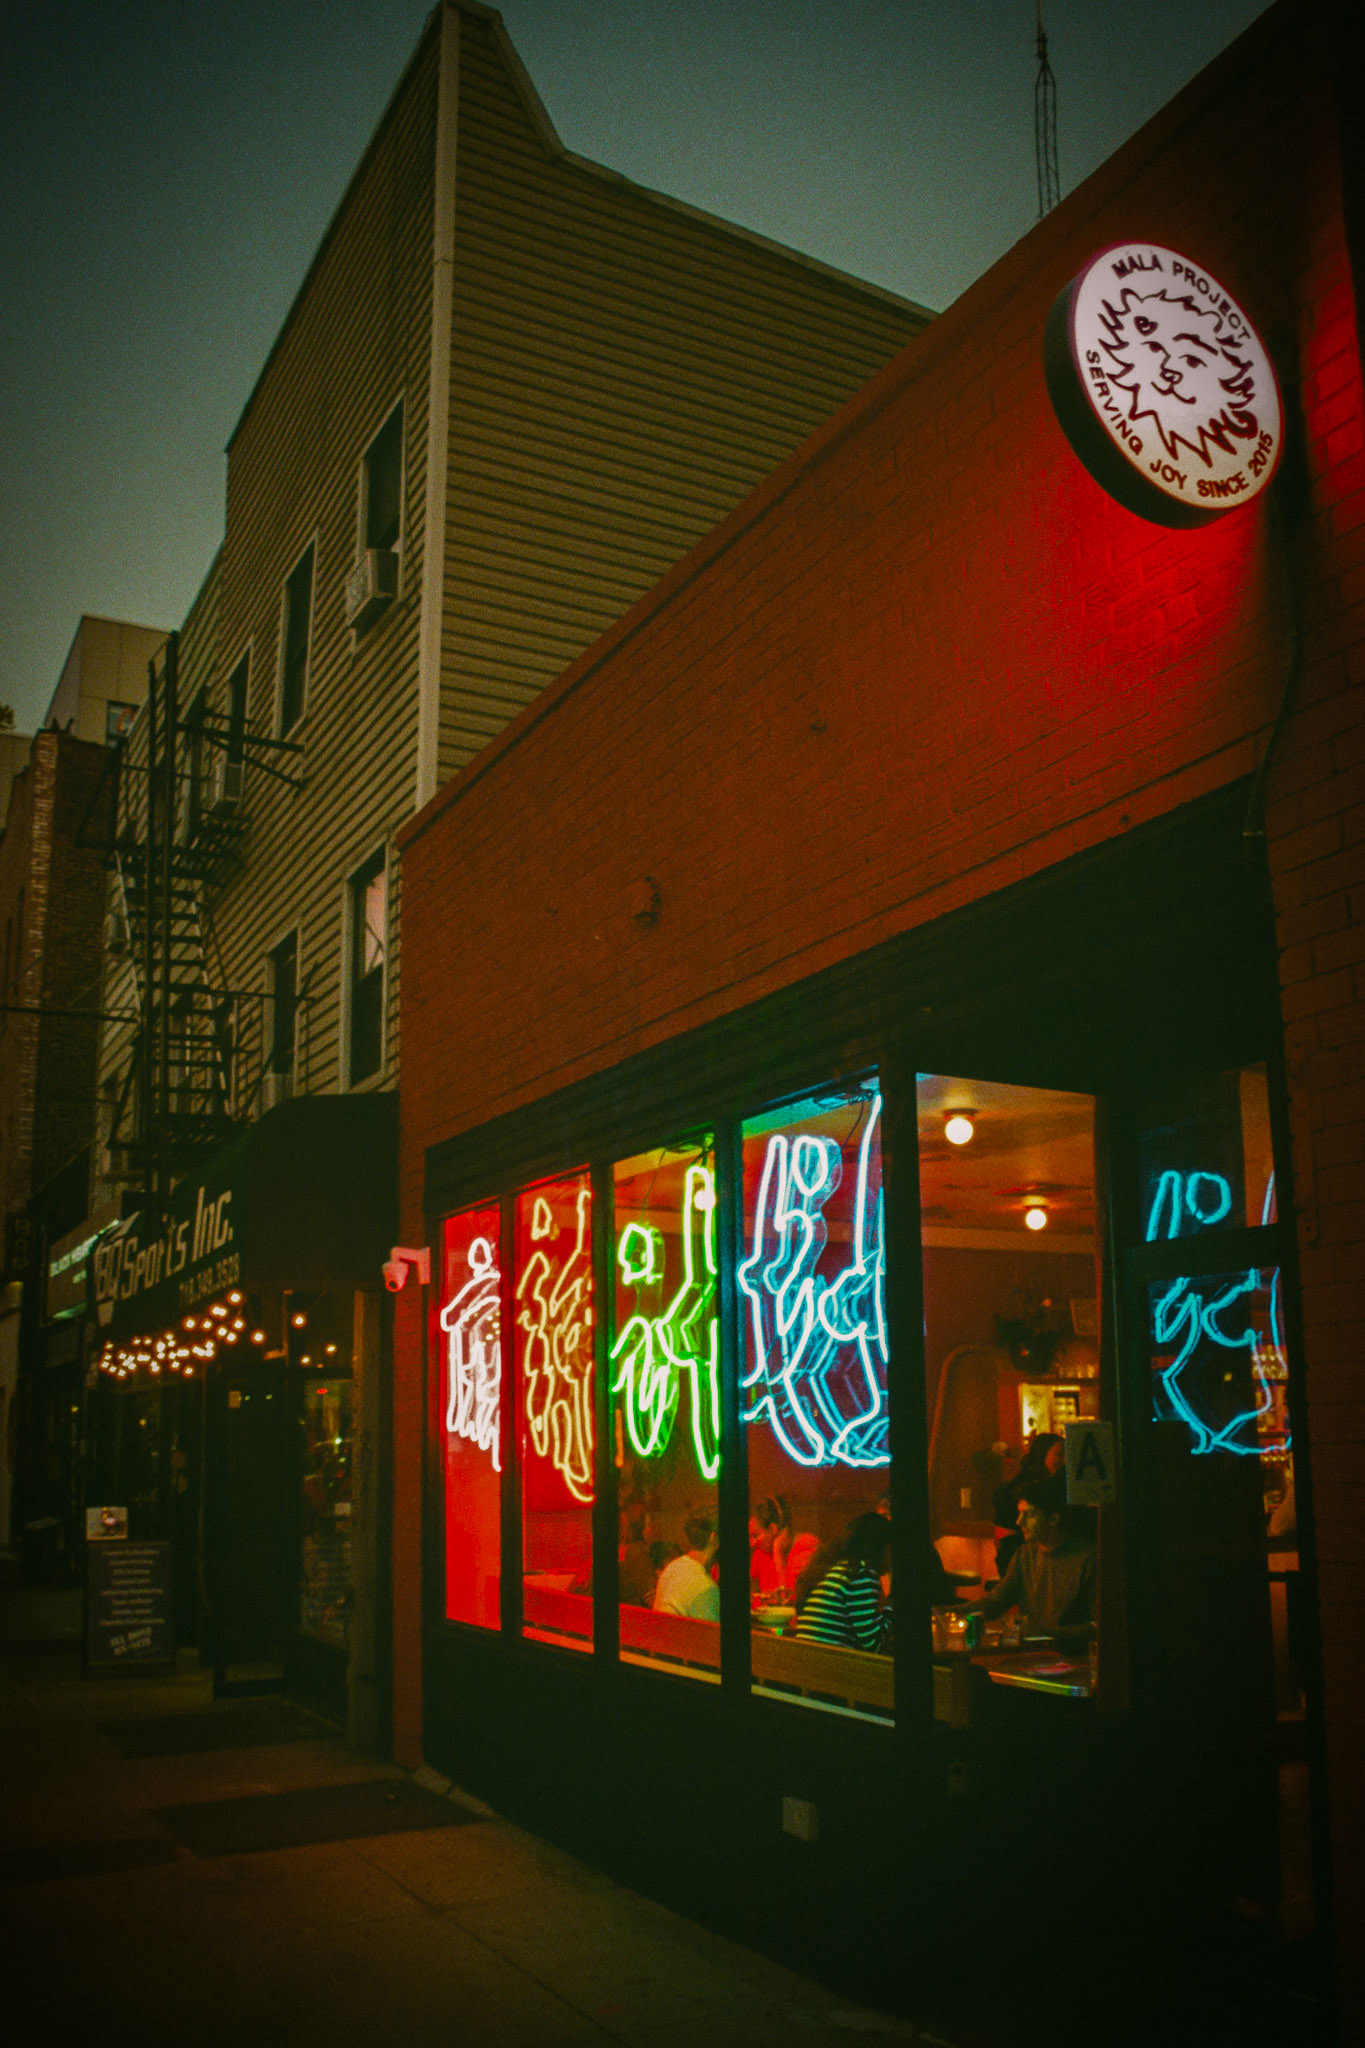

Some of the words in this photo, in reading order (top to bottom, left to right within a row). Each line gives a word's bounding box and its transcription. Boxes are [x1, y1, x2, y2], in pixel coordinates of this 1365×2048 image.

[1112, 254, 1162, 279] MALA
[1172, 261, 1252, 341] PROJECT
[1086, 349, 1144, 456] SERVING
[1150, 459, 1188, 490] JOY
[1197, 472, 1250, 498] SINCE
[1248, 430, 1273, 478] 2015
[1075, 1431, 1106, 1480] A
